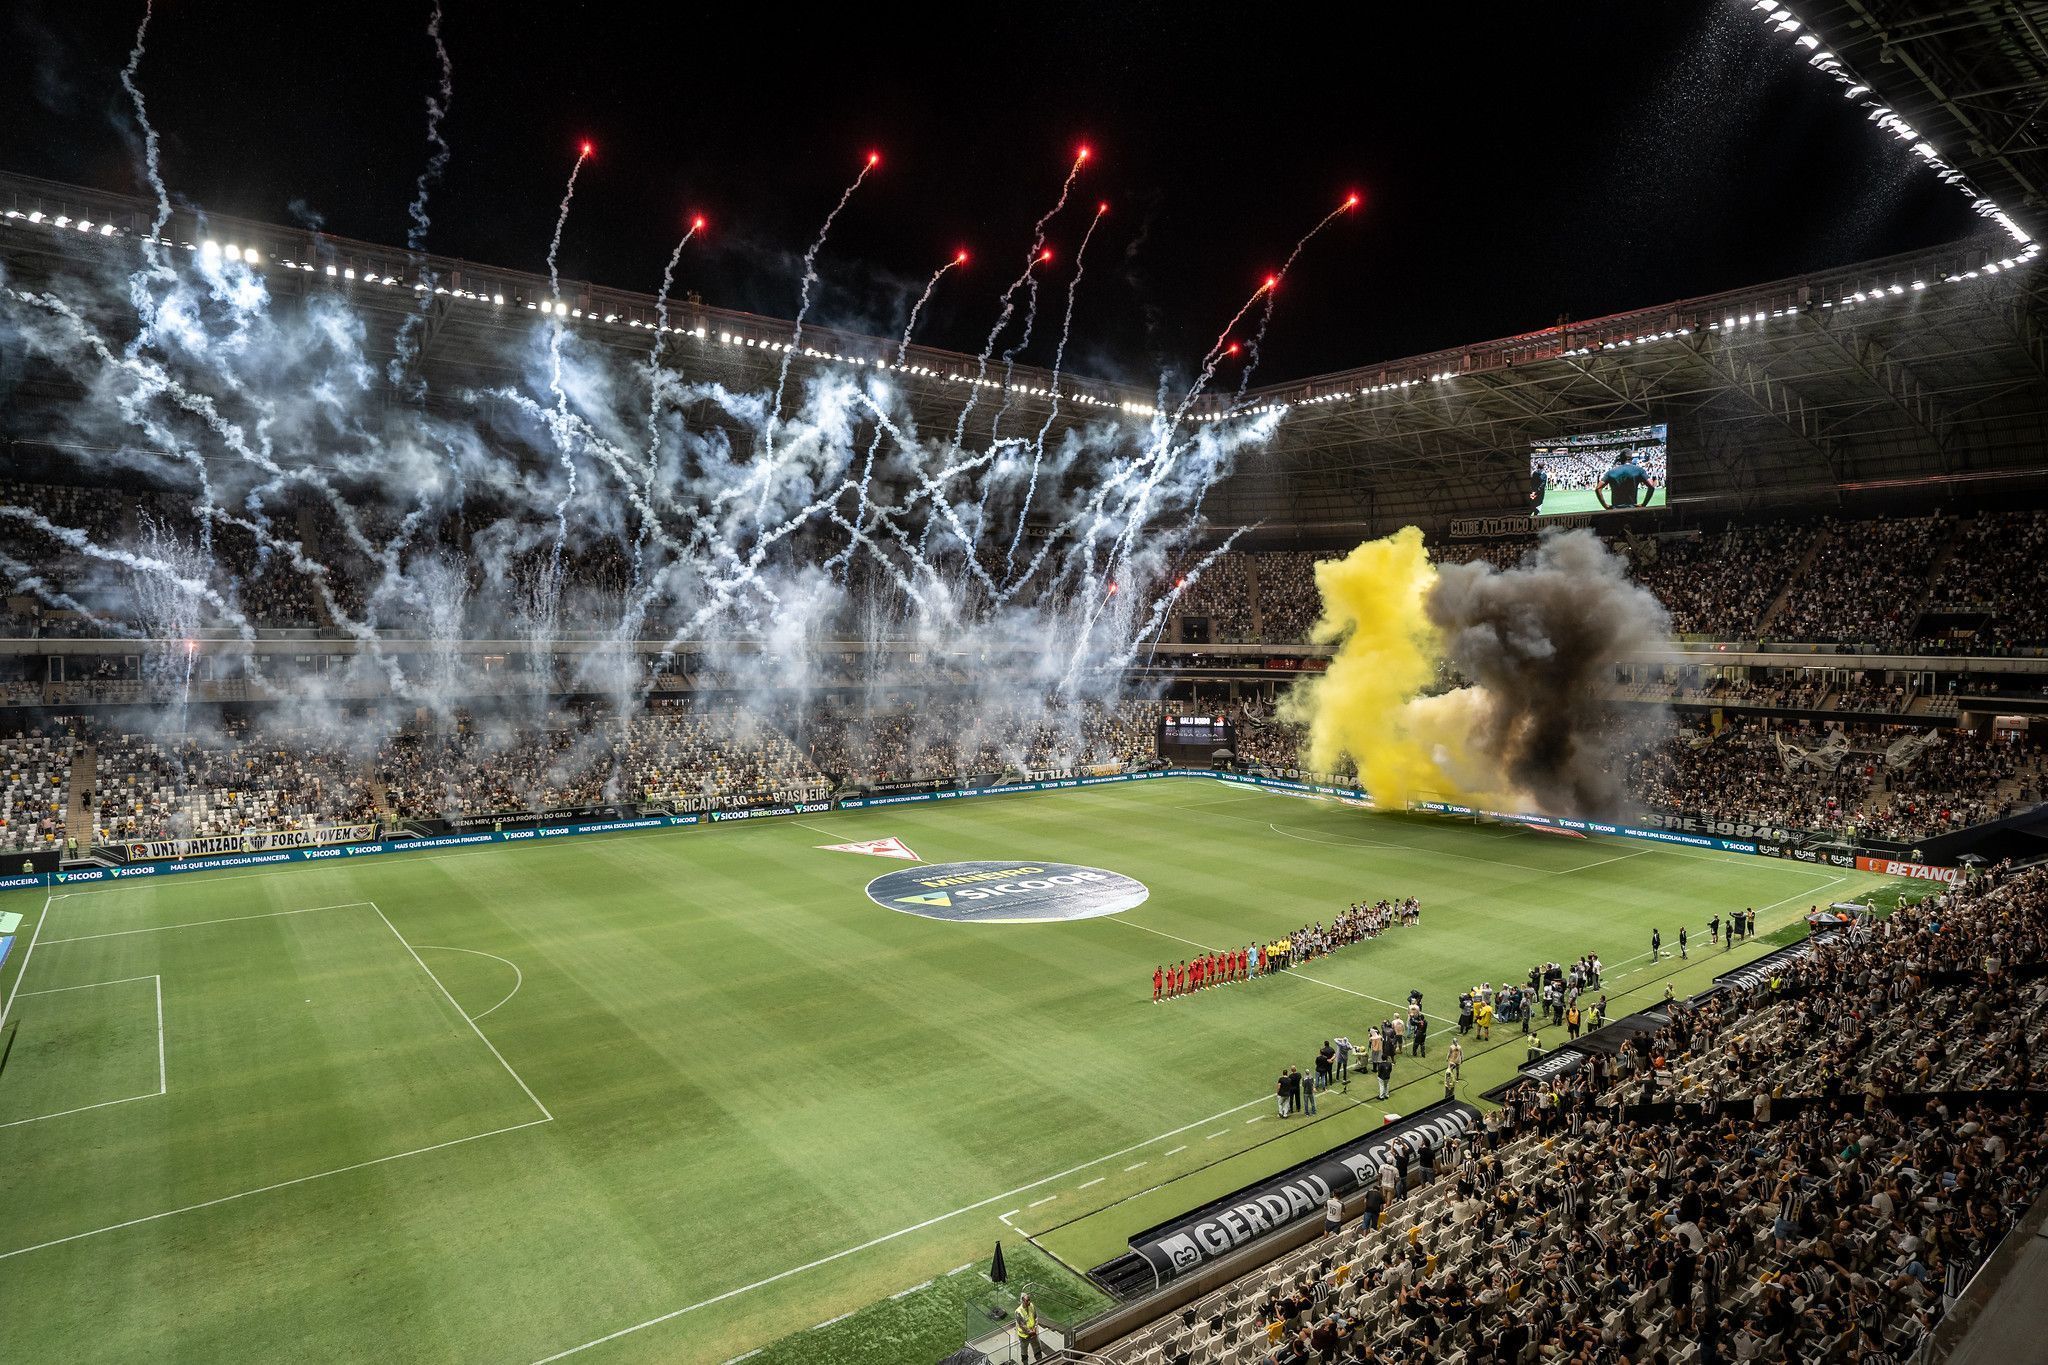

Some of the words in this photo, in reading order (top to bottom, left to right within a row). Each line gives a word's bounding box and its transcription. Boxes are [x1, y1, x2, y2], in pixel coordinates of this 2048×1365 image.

[1450, 520, 1480, 535] CLUBE
[802, 803, 829, 813] SICOOB
[451, 819, 474, 828] ARENA
[497, 816, 515, 824] CASA
[515, 813, 544, 823] PRÓPRIA
[554, 811, 573, 819] GALO
[676, 816, 697, 824] SICOOB
[720, 811, 750, 821] SICOOB
[602, 823, 614, 831] UMA
[613, 822, 635, 830] ESCOLHA
[1564, 820, 1585, 829] SICOOB
[1595, 825, 1617, 833] SICOOB
[510, 831, 535, 840] SICOOB
[545, 828, 570, 837] SICOOB
[1636, 830, 1648, 838] QUE
[1659, 833, 1682, 843] ESCOLHA
[1681, 836, 1712, 846] FINANCEIRA
[151, 836, 245, 858] UNIORMIZADA
[271, 831, 310, 848] FORÇA
[394, 842, 409, 850] MAIS
[408, 841, 421, 849] QUE
[421, 840, 436, 848] UMA
[435, 837, 461, 846] ESCOLHA
[461, 835, 493, 845] FINANCEIRA
[1729, 842, 1754, 852] SICOOB
[311, 848, 341, 859] SICOOB
[354, 844, 383, 855] SICOOB
[1759, 844, 1780, 854] BLINK
[1794, 849, 1816, 859] BLINK
[170, 862, 188, 871] MAIS
[188, 861, 204, 870] QUE
[204, 859, 221, 868] UMA
[221, 857, 251, 866] ESCOLHA
[251, 853, 290, 863] FINANCEIRA
[1831, 854, 1854, 865] BLINK
[67, 871, 103, 881] SICOOB
[121, 866, 155, 876] SICOOB
[920, 866, 1045, 888] MINEIRO
[955, 870, 1109, 900] SICOOB
[1537, 1050, 1584, 1073] GERDAU
[1368, 1108, 1472, 1168] GRDAU
[1193, 1174, 1331, 1250] GERDAU
